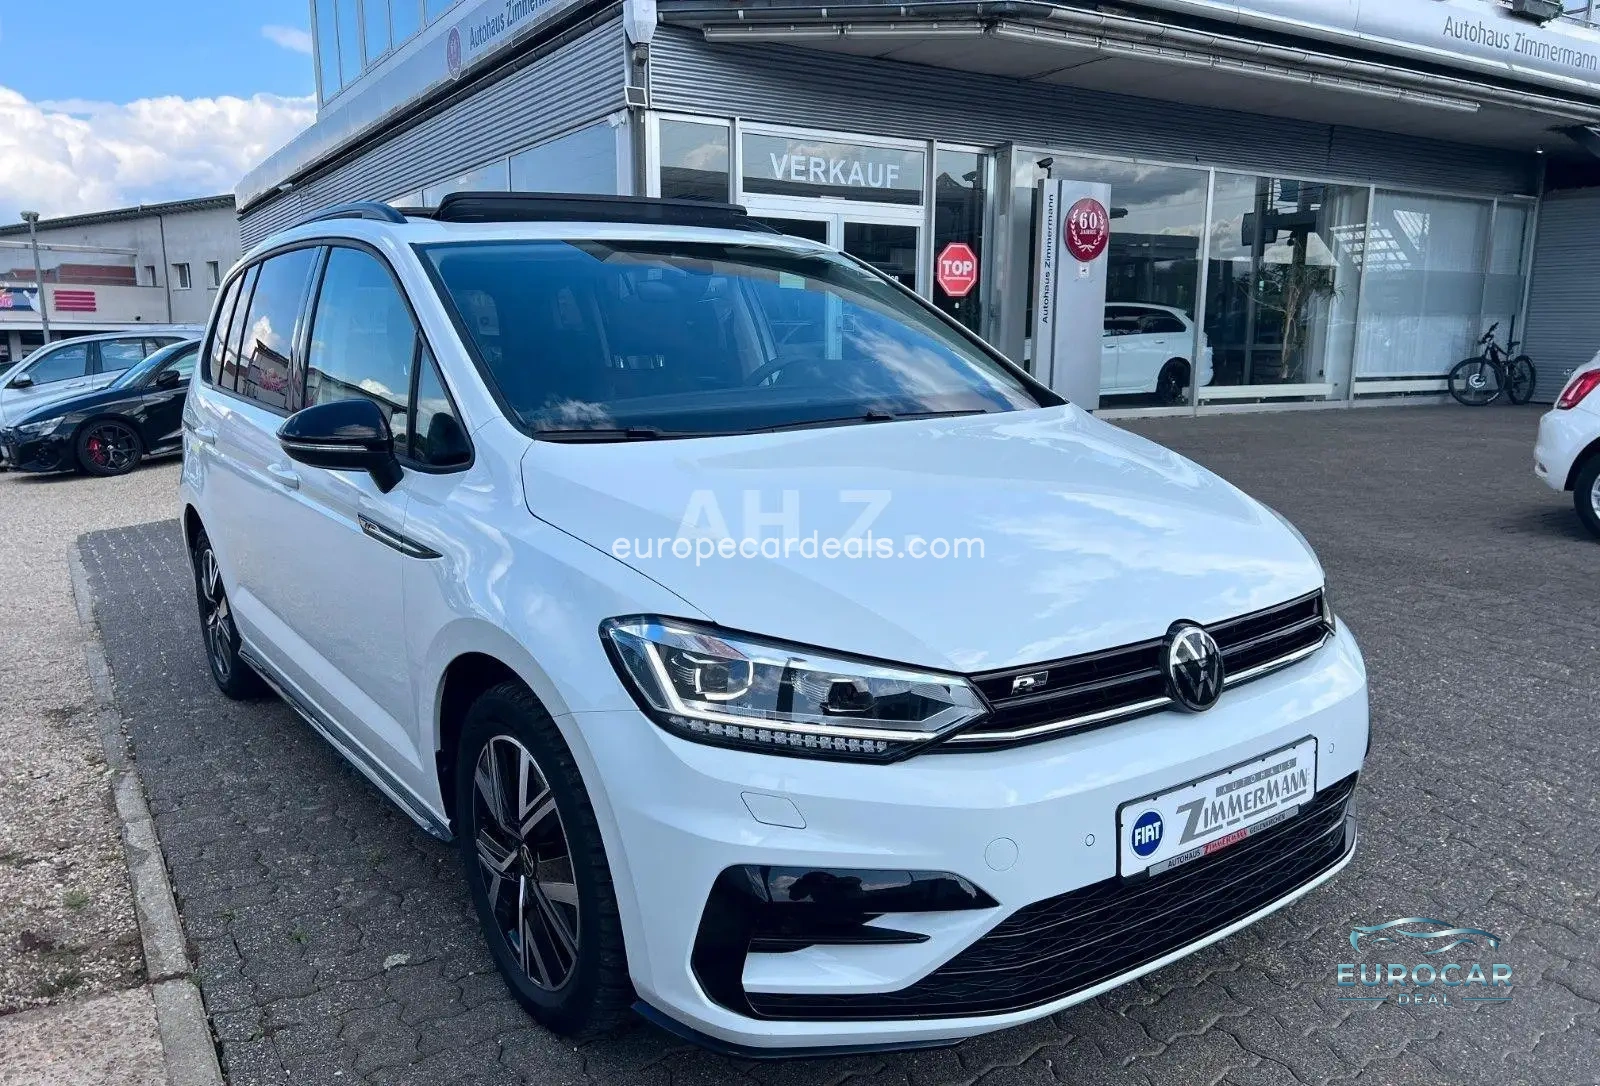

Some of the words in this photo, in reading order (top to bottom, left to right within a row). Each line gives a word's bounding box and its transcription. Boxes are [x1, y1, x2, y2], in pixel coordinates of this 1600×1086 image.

[469, 12, 505, 50] Autohaus
[1443, 15, 1510, 50] Autohaus
[1513, 32, 1598, 71] Zimmermann
[769, 152, 900, 189] VERKAUF
[1044, 194, 1054, 268] Zimmermann
[1079, 211, 1098, 230] 60
[942, 260, 973, 275] TOP
[1042, 271, 1051, 324] Autohaus
[1221, 760, 1292, 794] AUTOHAUS
[1133, 821, 1162, 847] FIAT
[1167, 850, 1201, 868] AUTOHAUS
